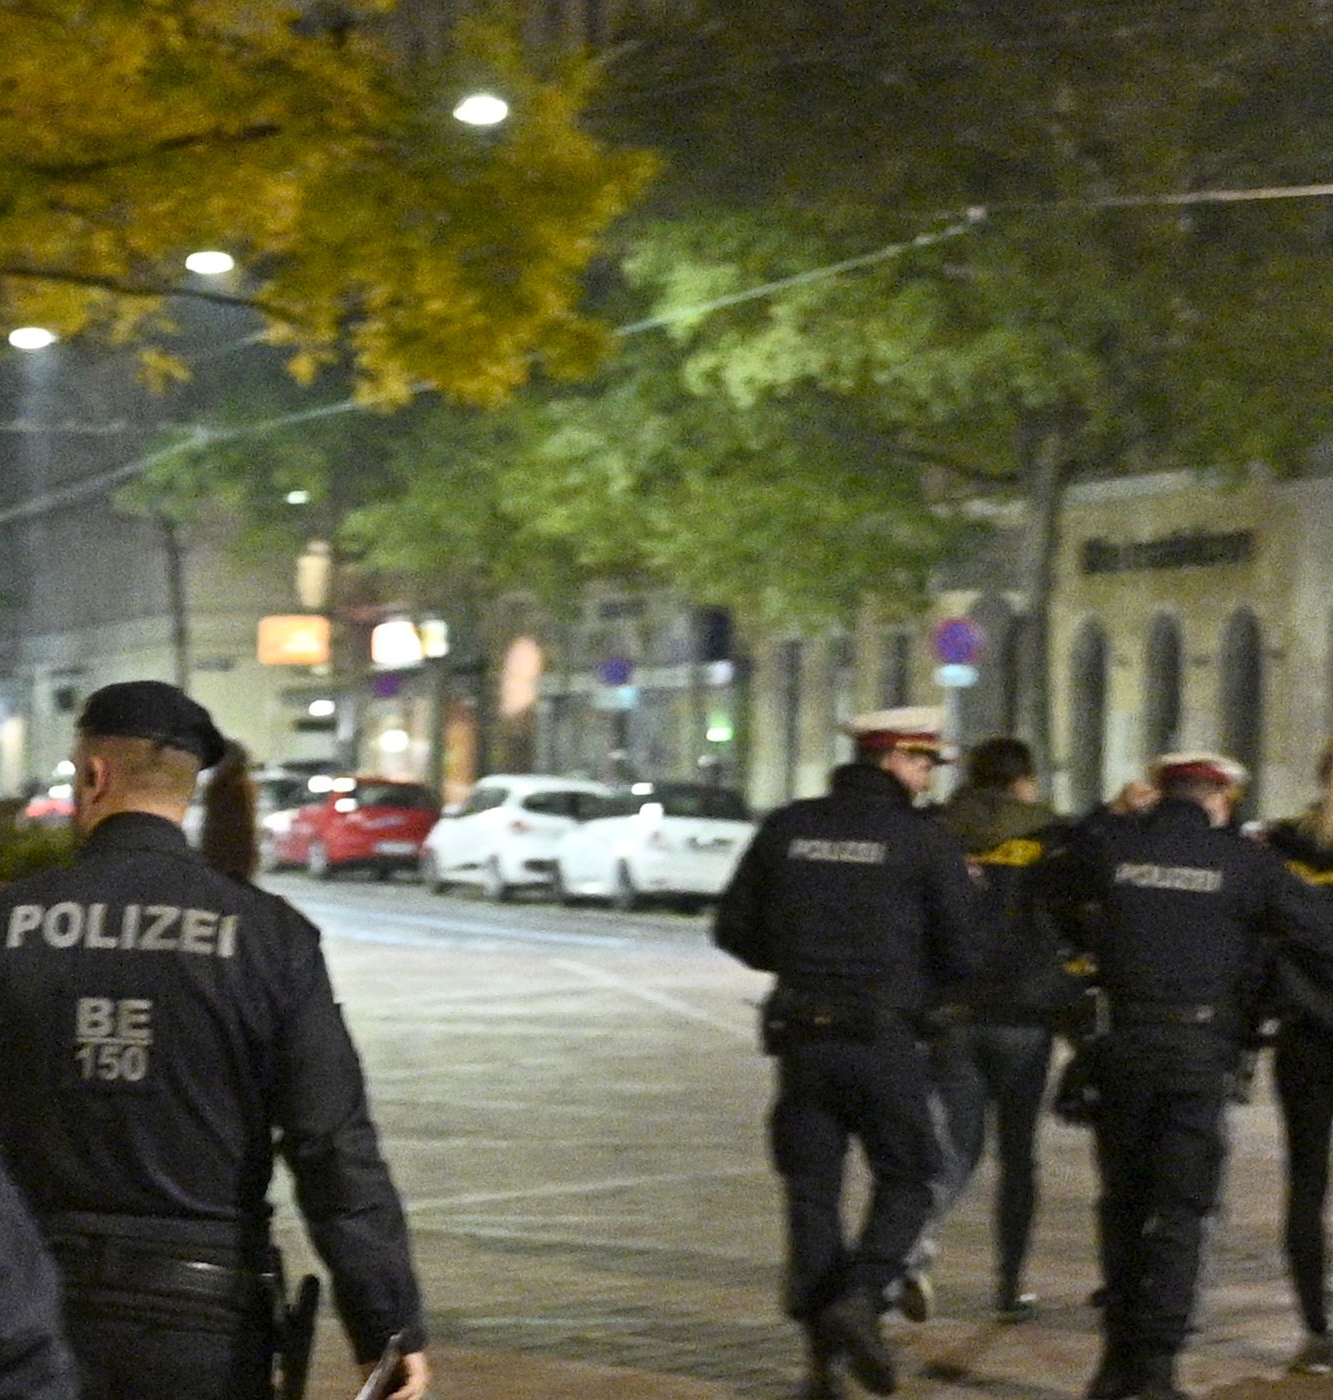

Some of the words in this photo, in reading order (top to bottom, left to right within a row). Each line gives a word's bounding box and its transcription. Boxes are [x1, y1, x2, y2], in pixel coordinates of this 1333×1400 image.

[6, 901, 241, 958] POLIZEI
[76, 996, 152, 1039] BE
[75, 1044, 147, 1082] 150
